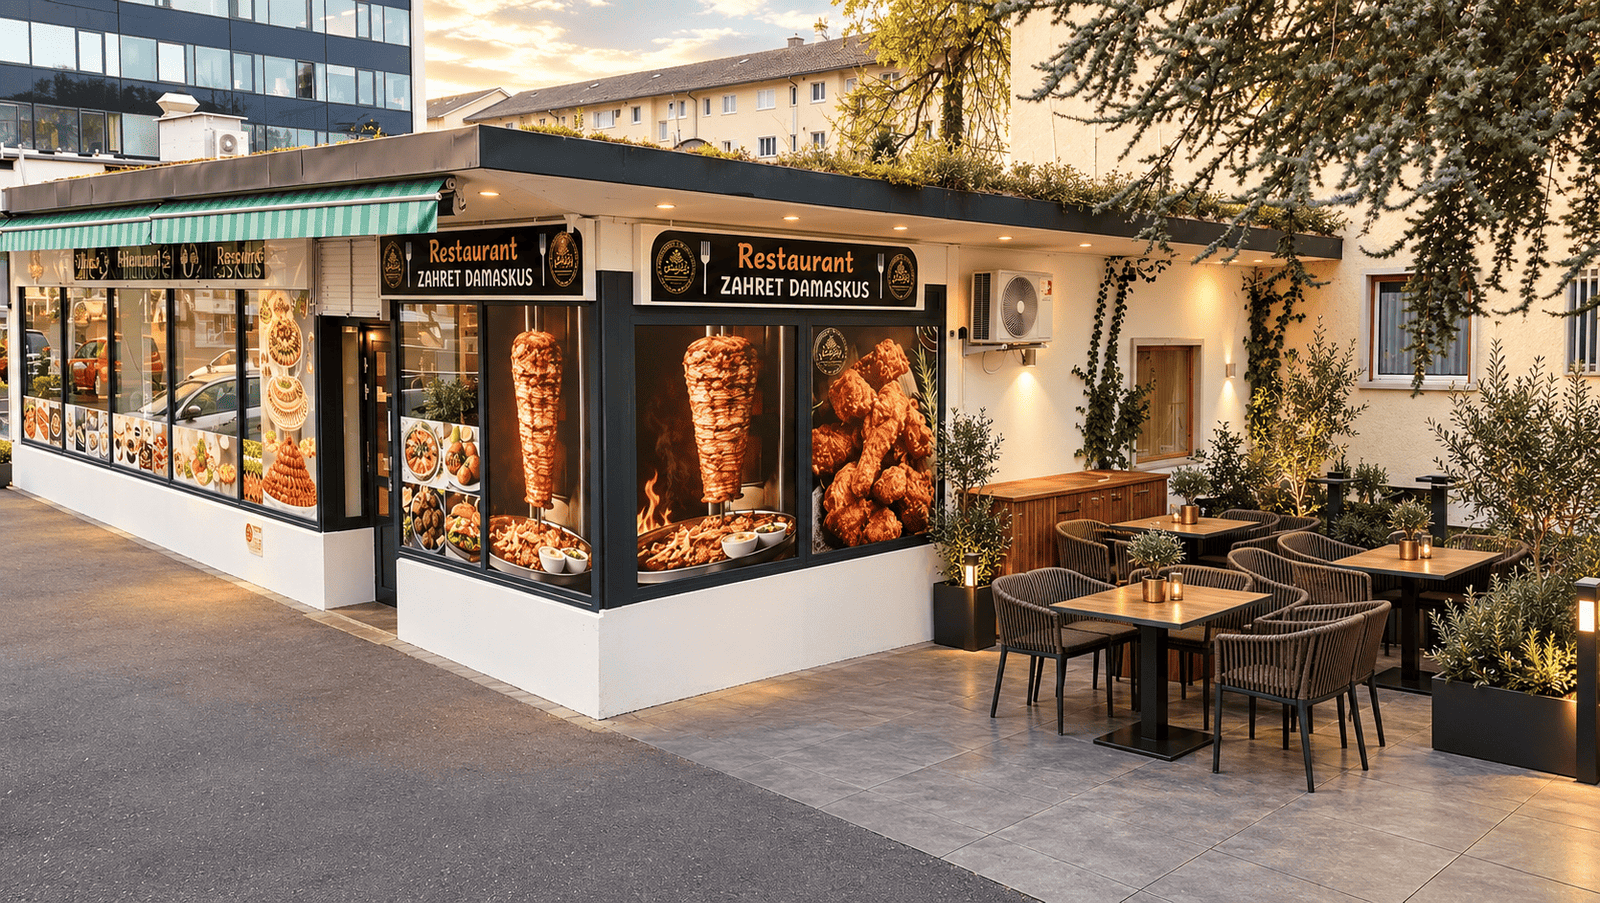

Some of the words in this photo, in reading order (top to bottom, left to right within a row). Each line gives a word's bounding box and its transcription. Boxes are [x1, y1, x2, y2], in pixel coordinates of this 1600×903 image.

[429, 236, 518, 263] Restaurant
[737, 242, 854, 273] Restaurant
[417, 269, 462, 288] ZAHRET
[466, 267, 533, 287] DAMASKUS
[720, 275, 783, 297] ZAHRET
[789, 278, 870, 299] DAMASKUS
